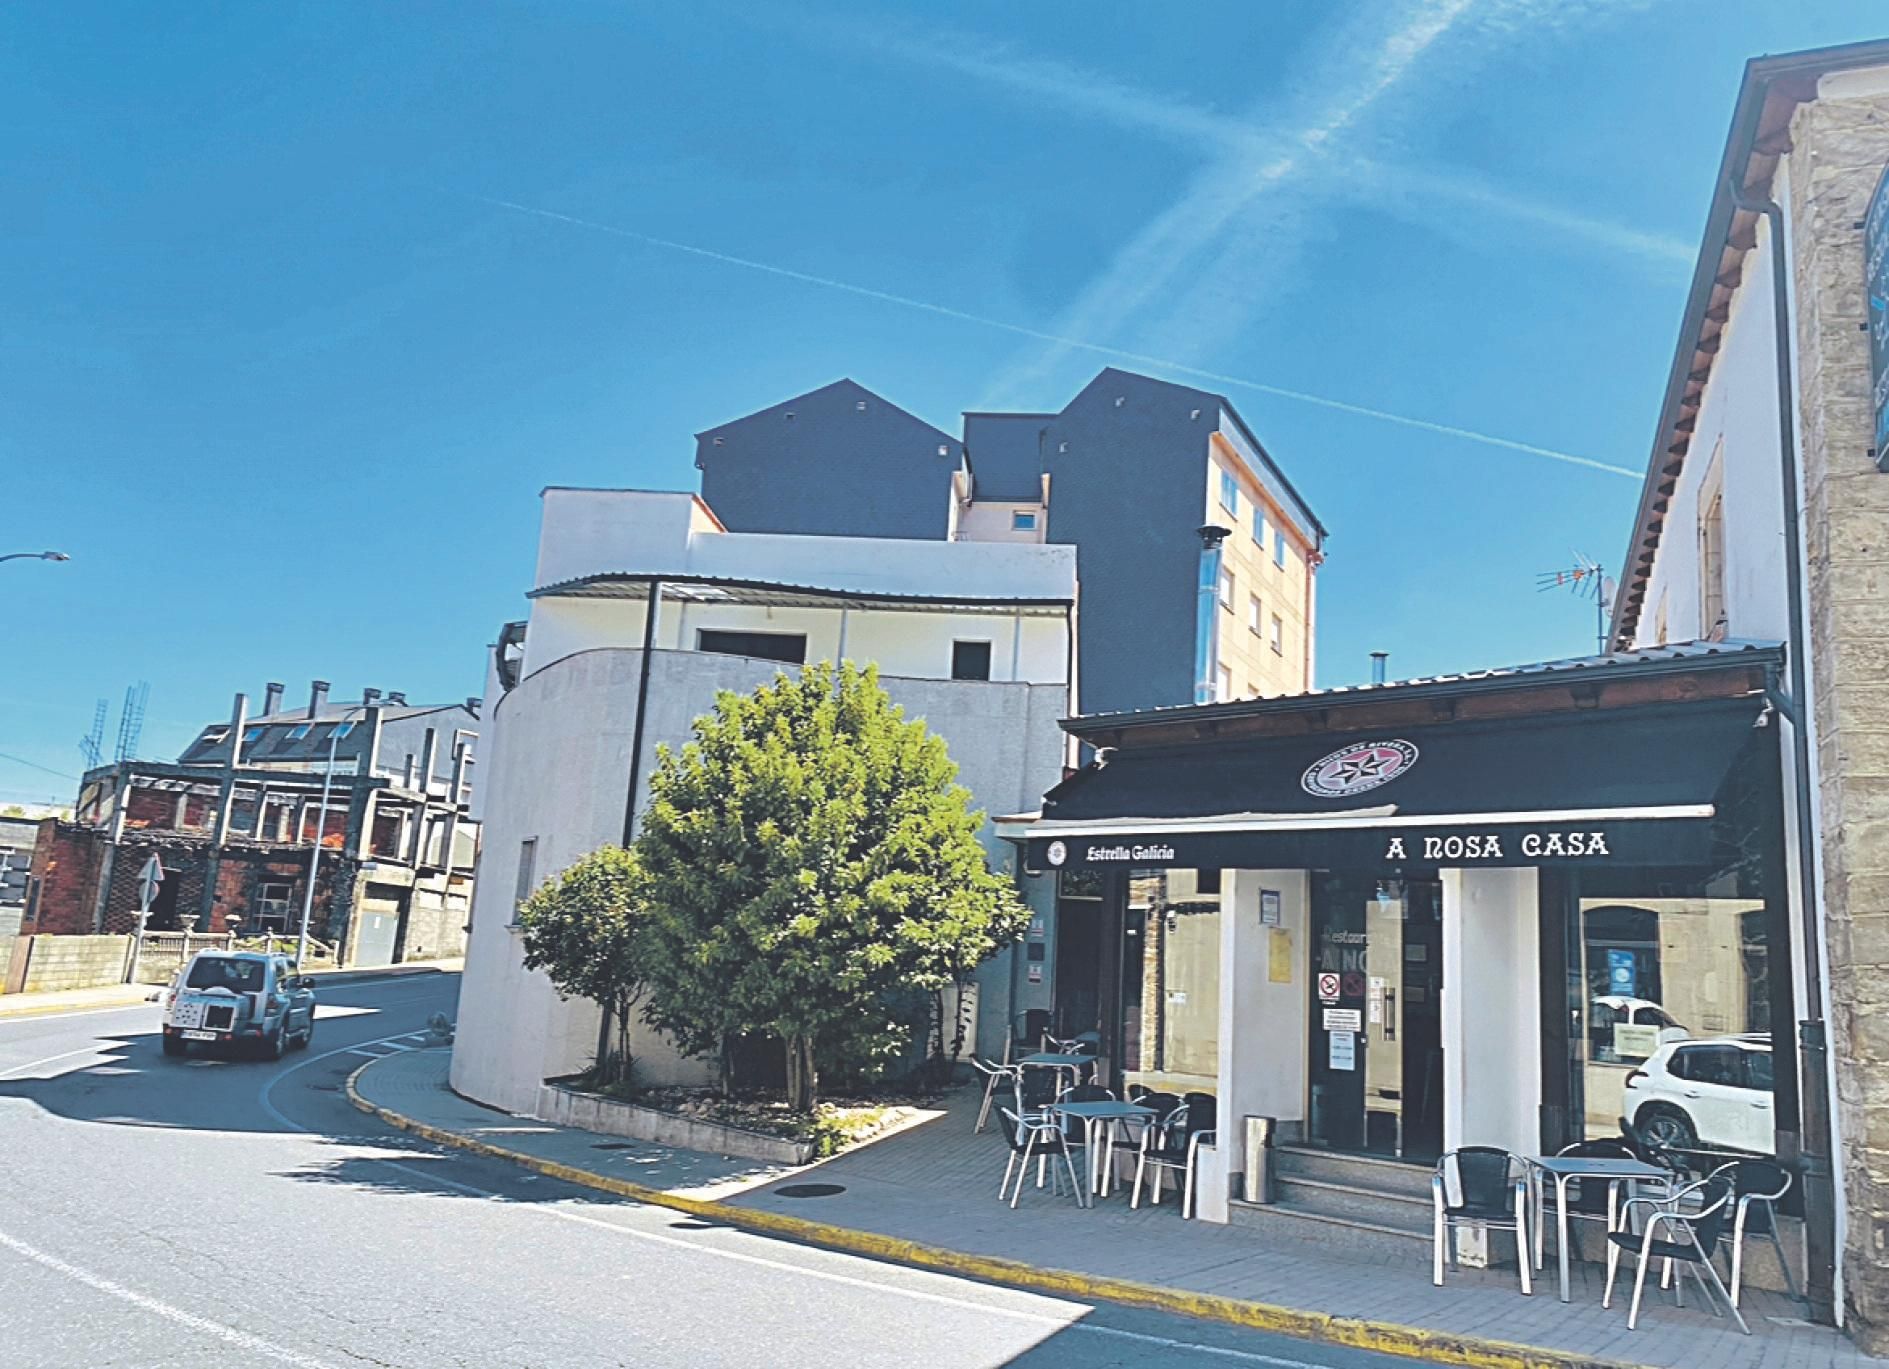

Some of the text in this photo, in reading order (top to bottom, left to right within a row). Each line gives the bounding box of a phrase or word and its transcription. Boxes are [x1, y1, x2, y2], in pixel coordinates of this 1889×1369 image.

[1086, 843, 1175, 861] Estrella Galicia
[1386, 832, 1610, 859] A NOSA CASA
